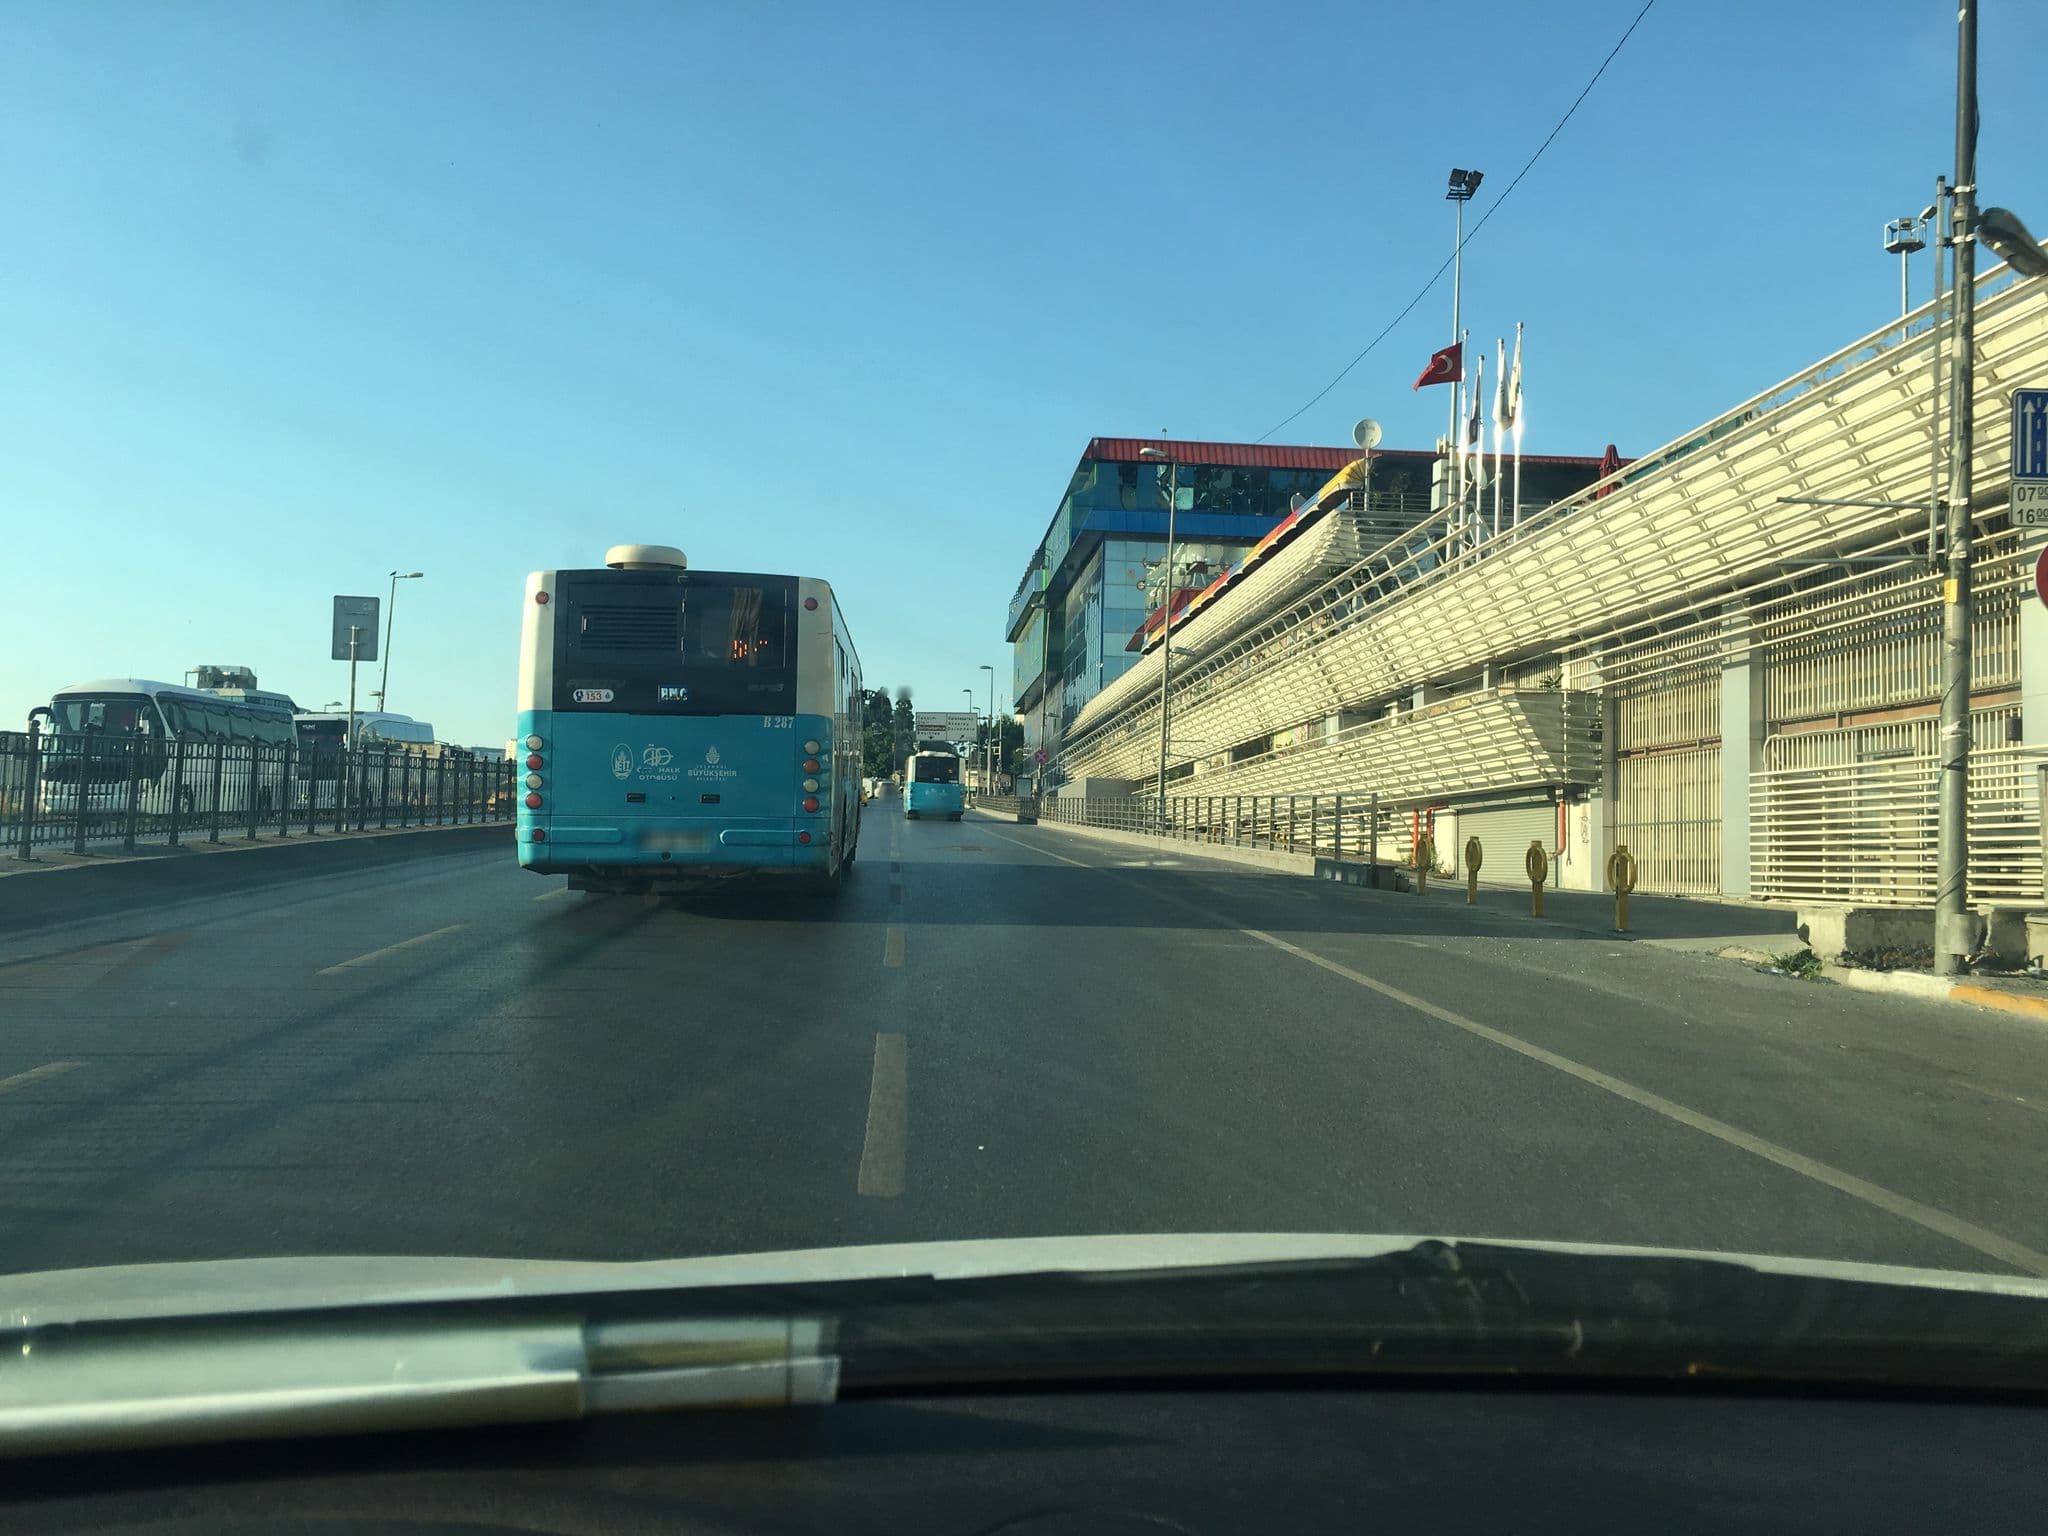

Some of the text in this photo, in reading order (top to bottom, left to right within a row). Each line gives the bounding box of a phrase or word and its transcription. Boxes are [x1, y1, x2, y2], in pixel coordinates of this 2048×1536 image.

[586, 692, 602, 700] 153
[763, 717, 795, 729] B 287
